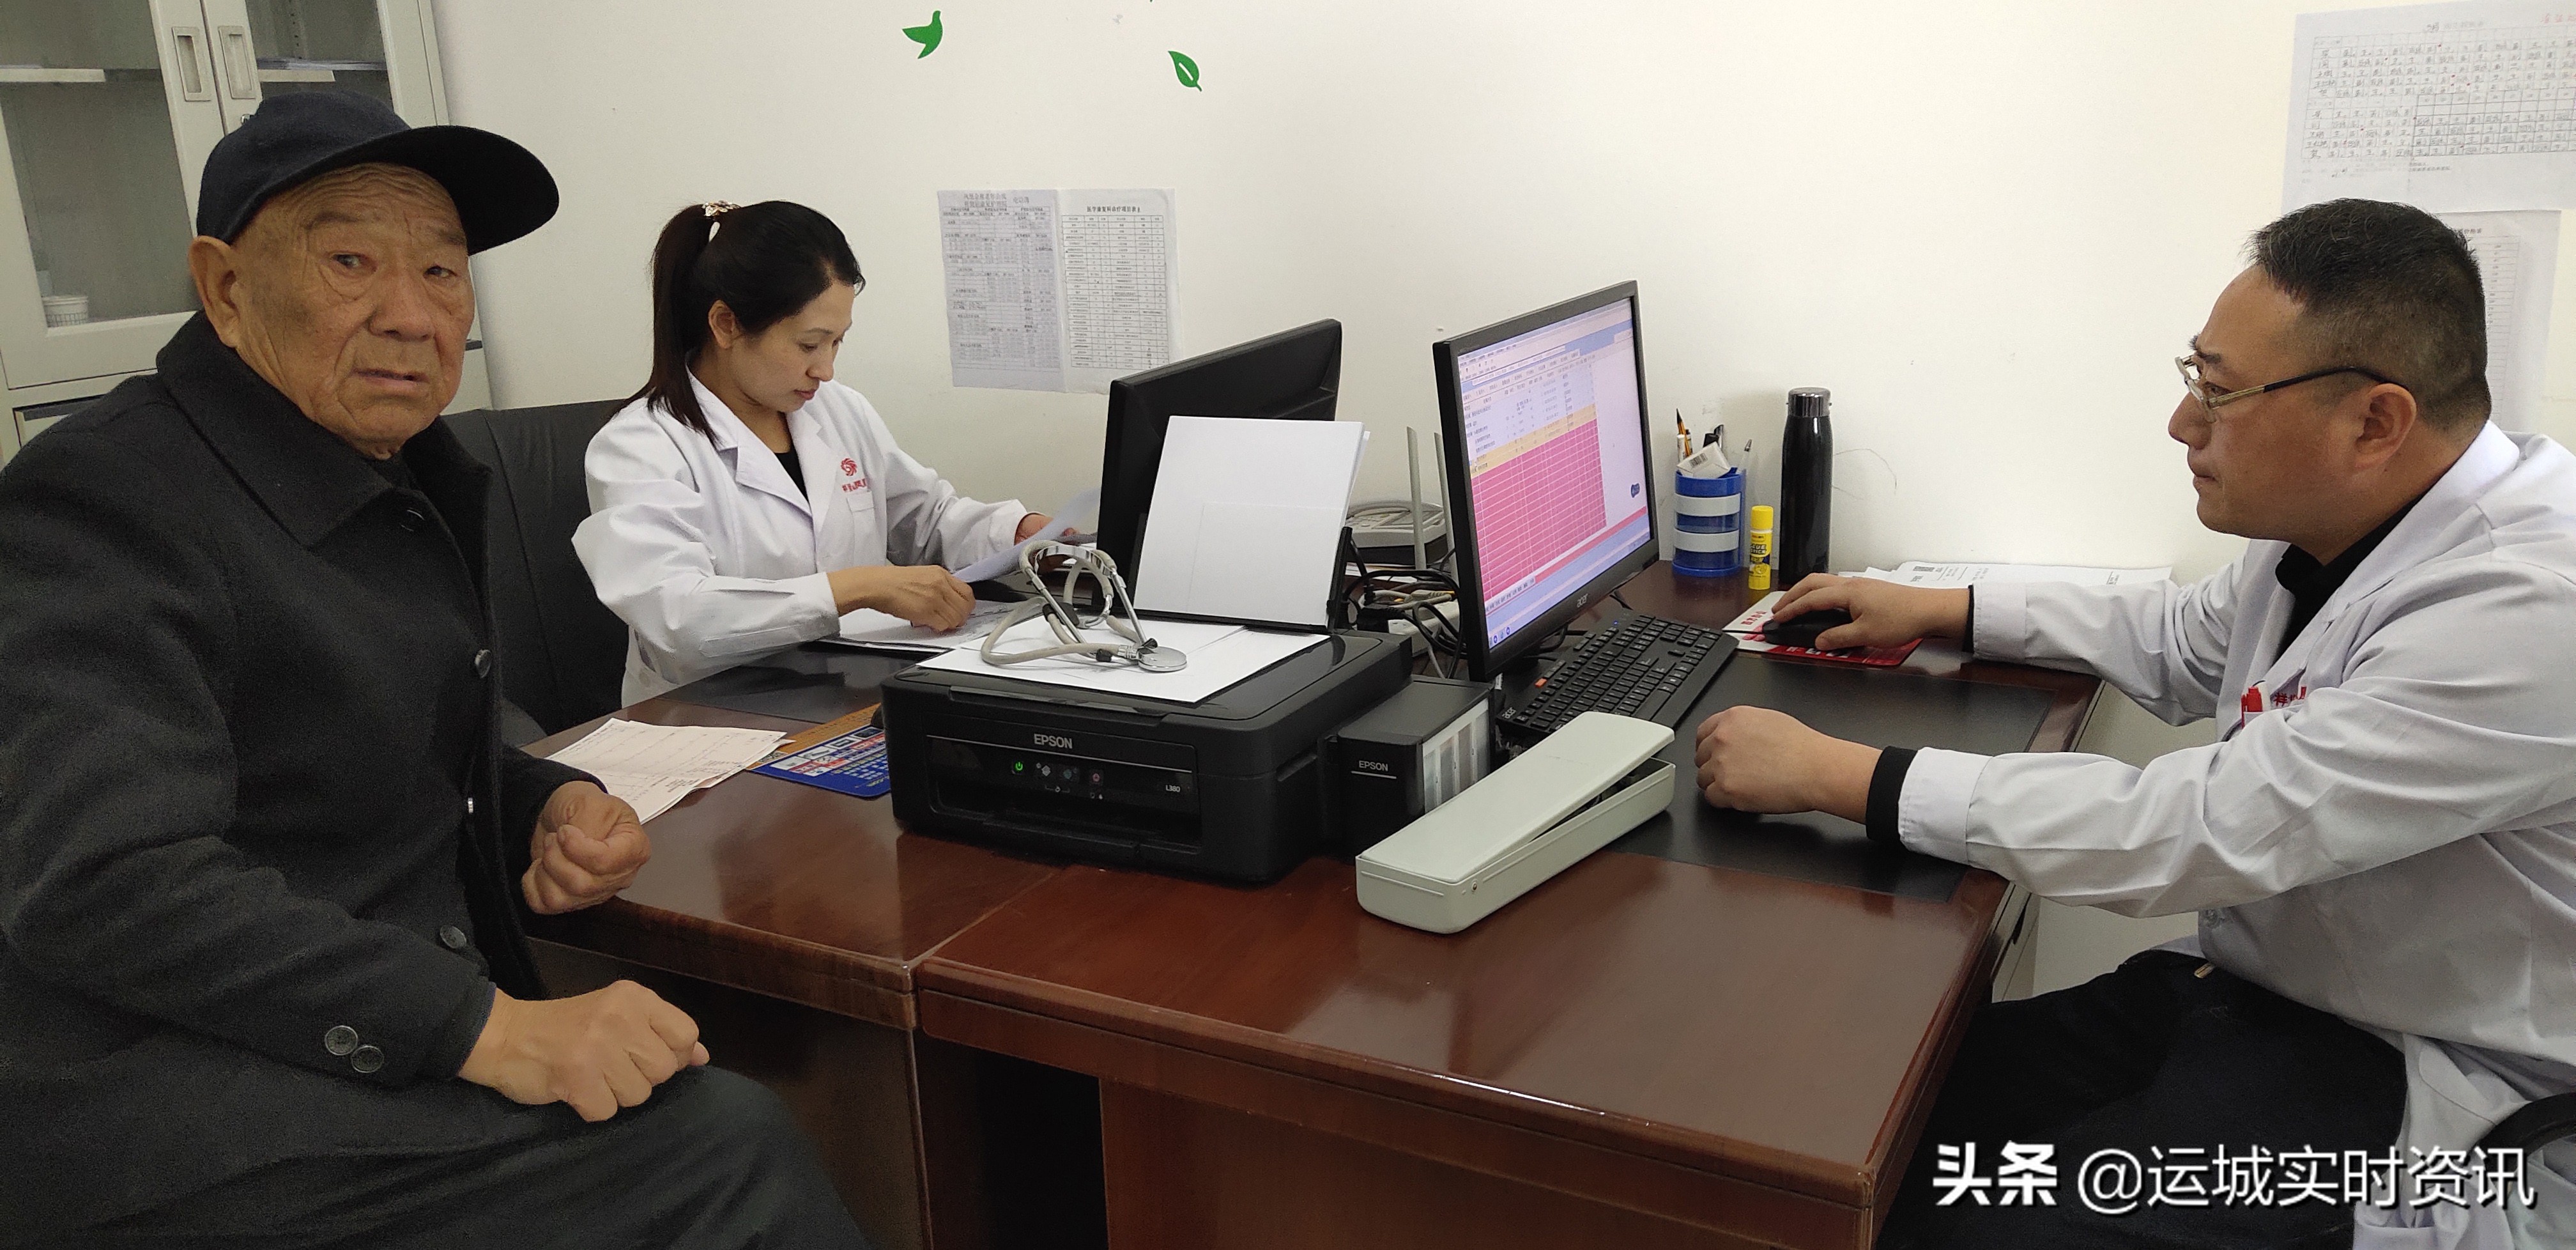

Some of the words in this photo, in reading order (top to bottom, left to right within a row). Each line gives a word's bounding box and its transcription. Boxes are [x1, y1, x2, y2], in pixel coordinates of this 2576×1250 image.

[1576, 593, 1588, 608] acer
[1499, 706, 1517, 719] acer
[1033, 733, 1073, 749] EPSON
[1358, 760, 1388, 772] EPSON
[1165, 784, 1181, 793] L380
